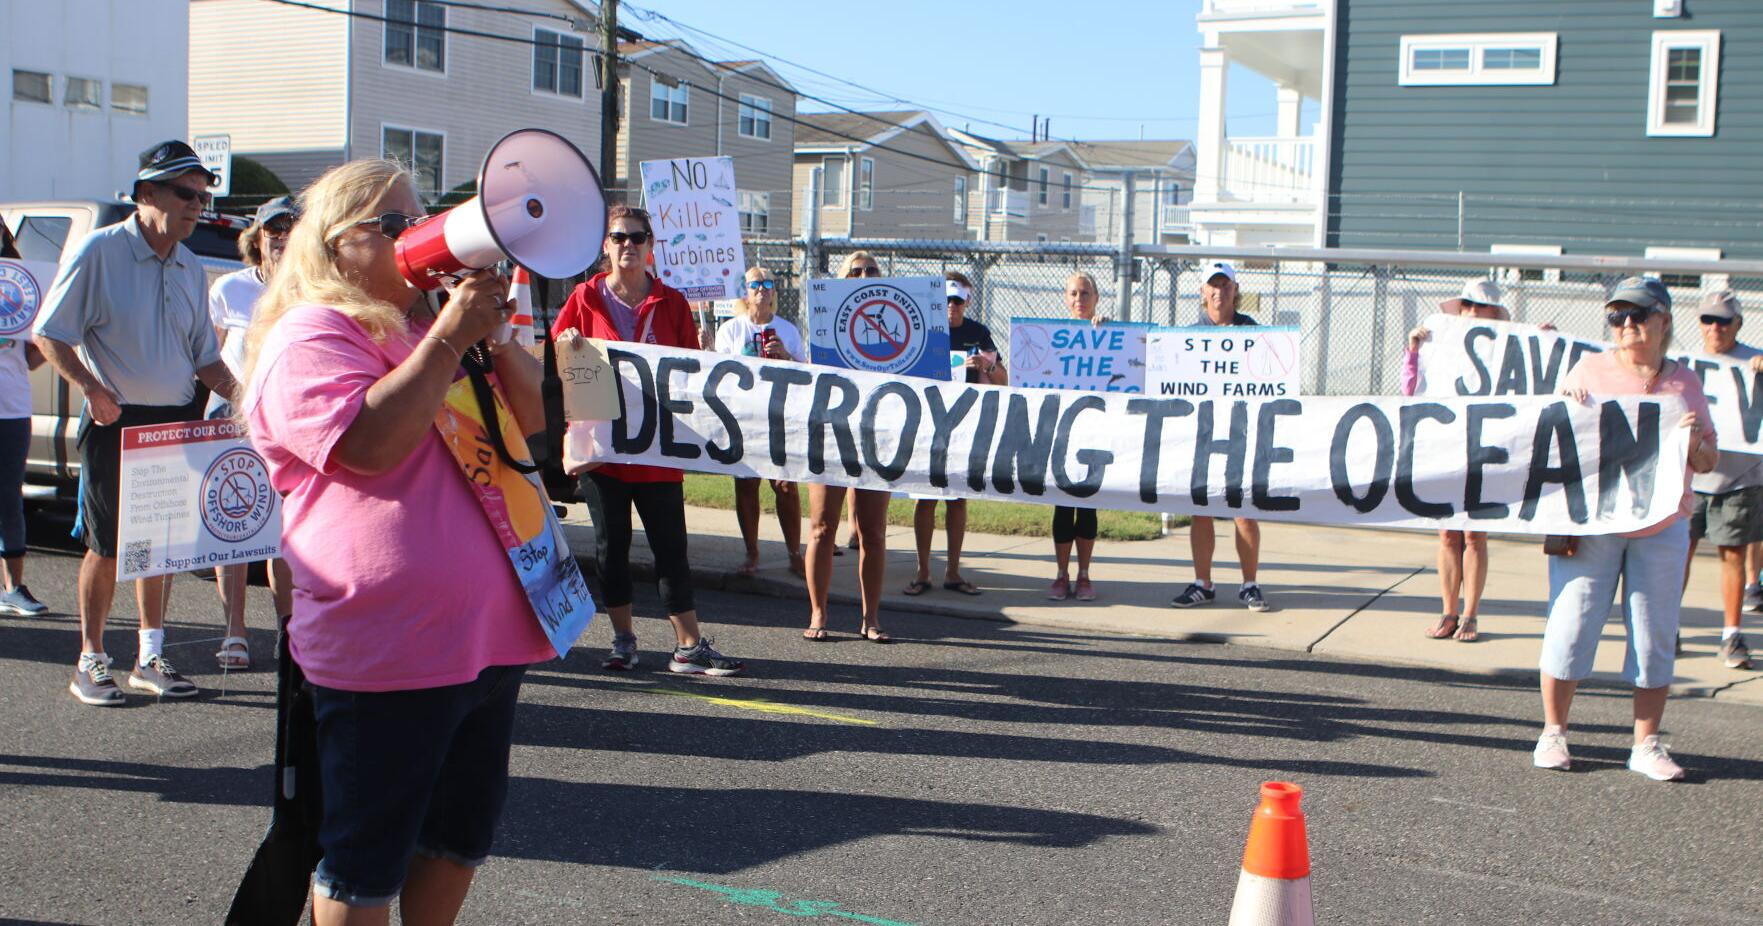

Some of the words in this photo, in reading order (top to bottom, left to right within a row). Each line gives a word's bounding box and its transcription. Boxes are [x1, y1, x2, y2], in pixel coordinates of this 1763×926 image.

[197, 141, 227, 152] SPEED
[204, 154, 223, 163] IMIT
[670, 159, 708, 192] NO
[658, 201, 722, 230] Killer
[656, 239, 735, 266] Turbines
[813, 284, 826, 292] ME
[930, 281, 942, 289] NJ
[814, 306, 828, 314] MA
[839, 305, 853, 333] EAST
[854, 289, 889, 304] COAST
[893, 293, 921, 331] UNITED
[930, 303, 943, 311] DE
[816, 328, 828, 337] CT
[931, 325, 945, 333] MD
[1051, 329, 1125, 351] SAVE
[1184, 337, 1256, 352] STOP
[562, 366, 602, 384] STOP
[1059, 355, 1114, 377] THE
[1200, 359, 1240, 375] THE
[1160, 381, 1209, 397] WIND
[1222, 382, 1287, 397] FARMS
[137, 428, 191, 444] PROTECT
[193, 425, 216, 438] OUR
[606, 346, 1115, 498] DESTROYING
[1125, 397, 1303, 511] THE
[1329, 400, 1661, 525] OCEAN
[220, 456, 255, 476] STOP
[207, 489, 248, 533] OFFSHORE
[251, 483, 268, 522] WIND
[164, 553, 207, 569] Support
[208, 549, 229, 562] Our
[231, 544, 277, 560] Lawsuits
[519, 541, 550, 572] Stop
[539, 582, 574, 634] Wind
